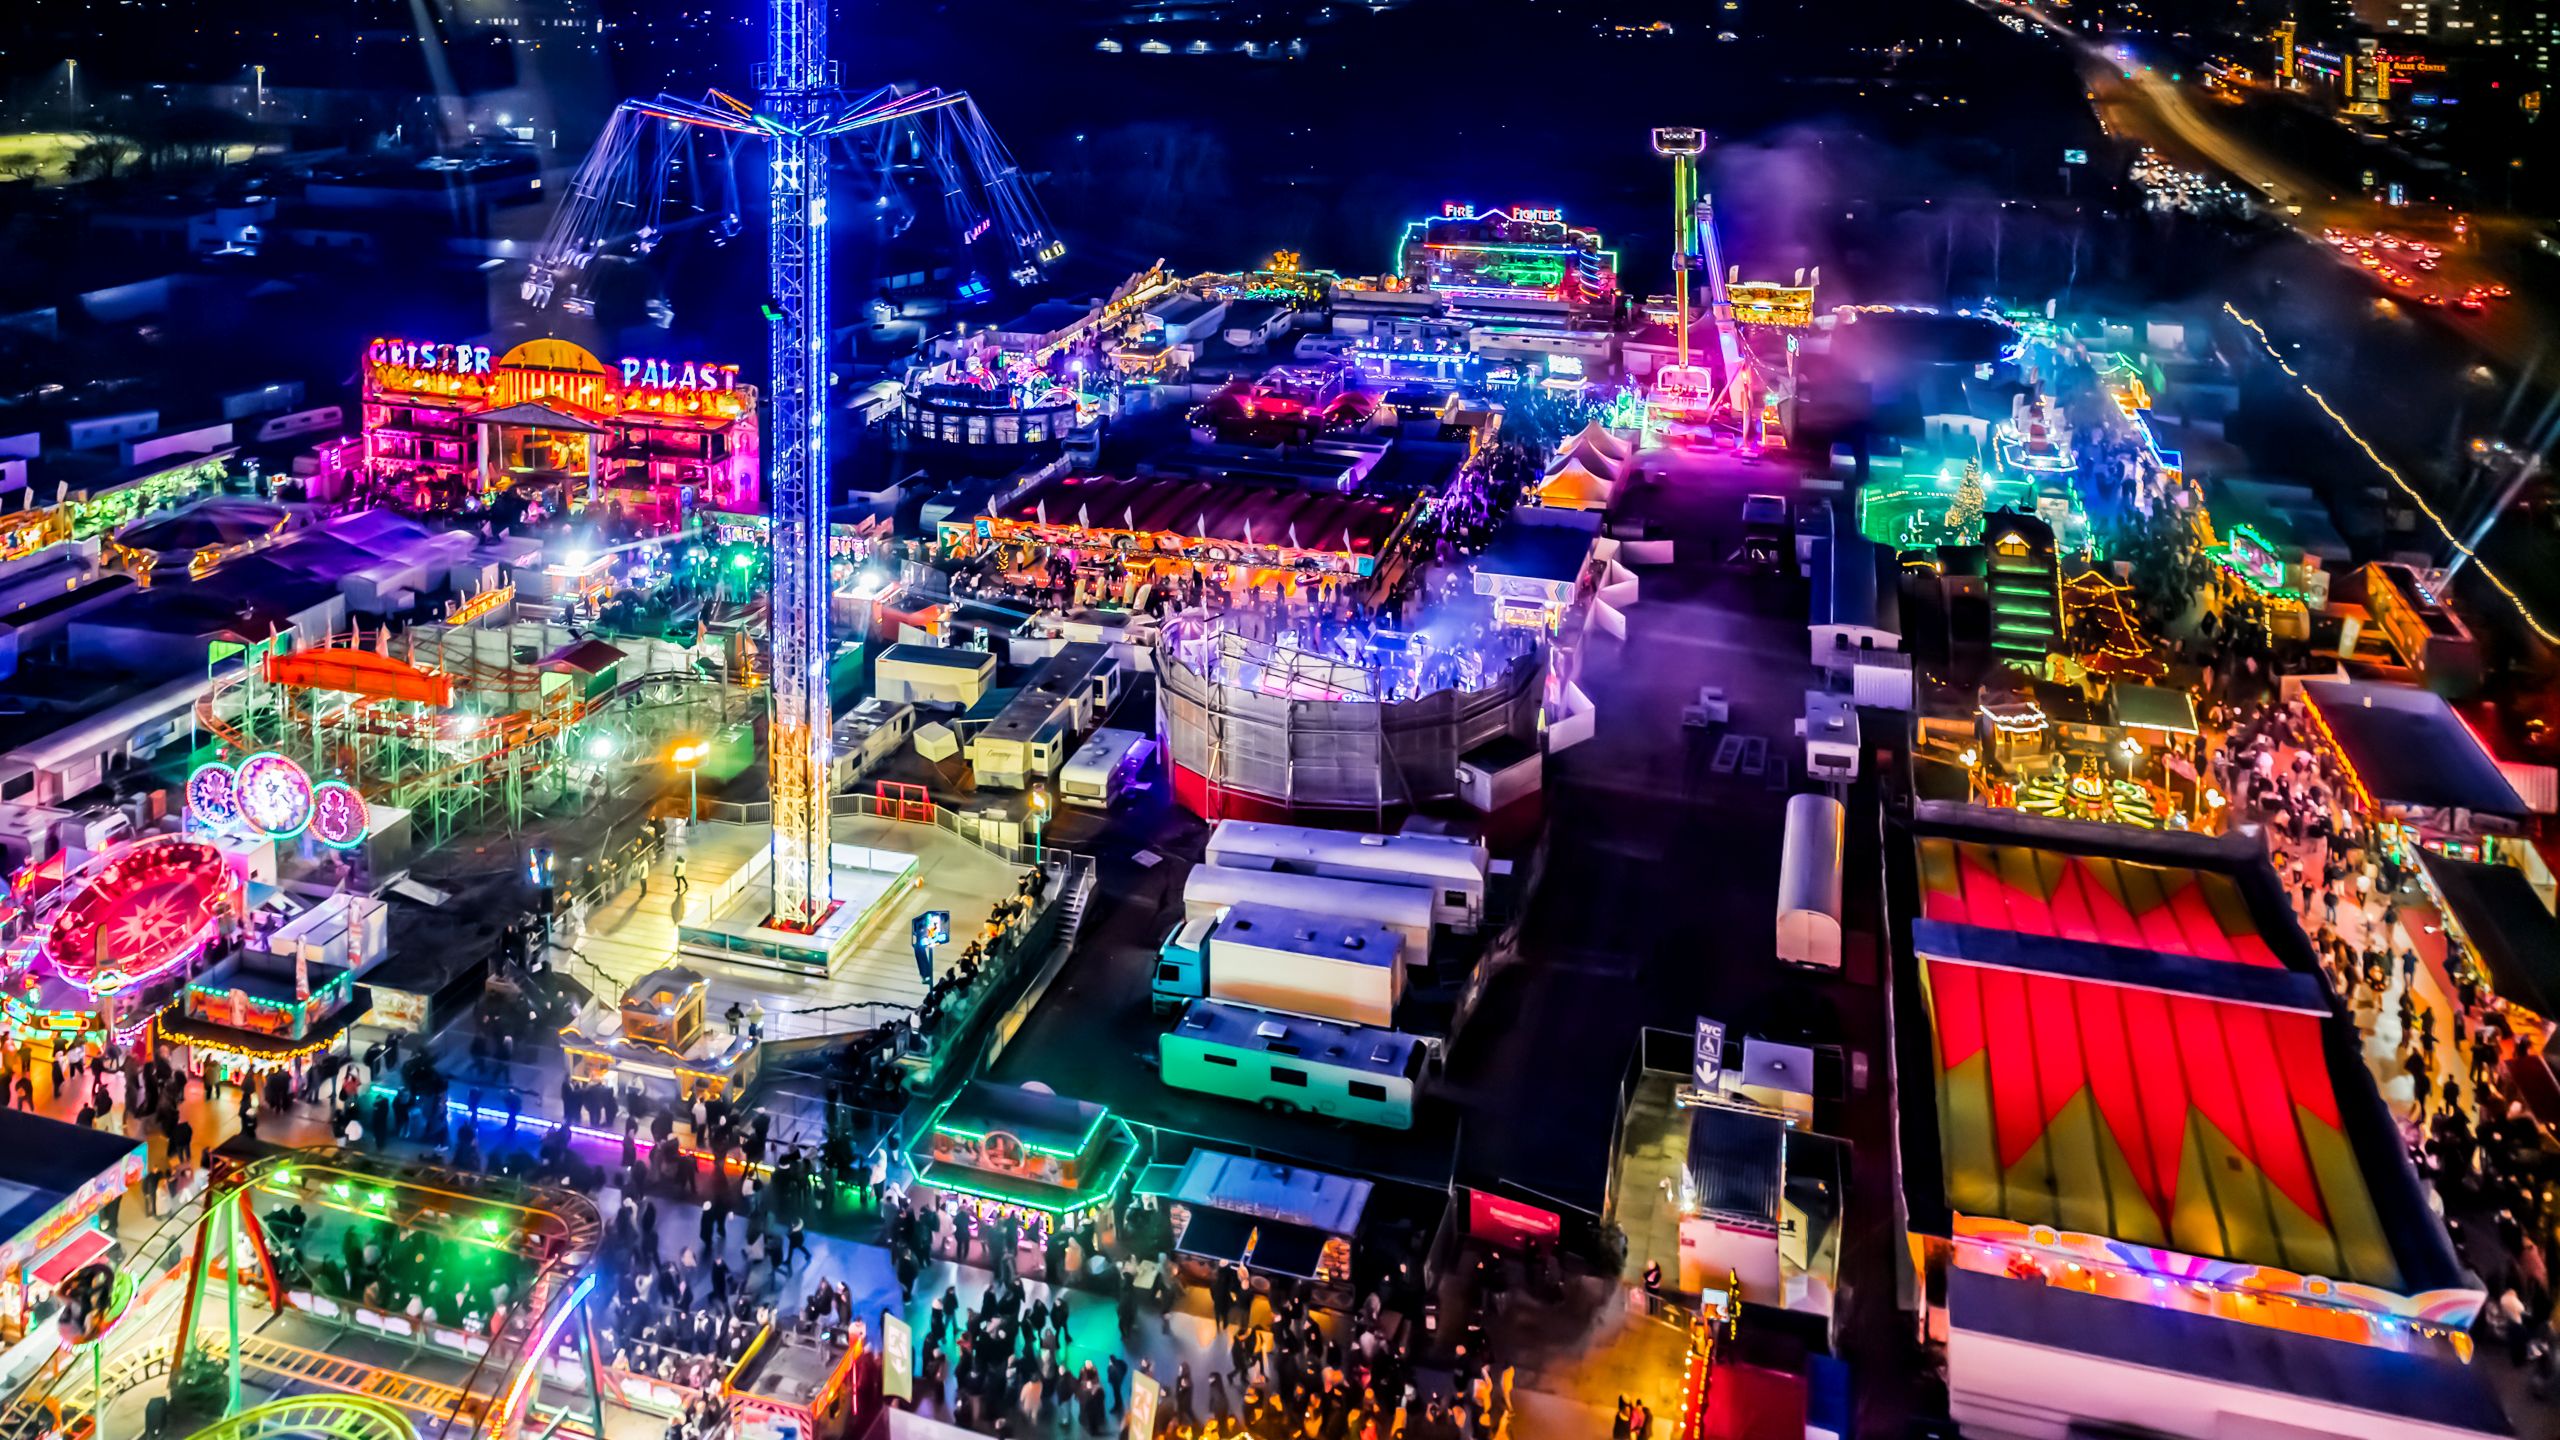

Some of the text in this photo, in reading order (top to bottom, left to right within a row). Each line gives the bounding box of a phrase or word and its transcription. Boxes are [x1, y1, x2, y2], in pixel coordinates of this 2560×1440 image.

[1445, 204, 1562, 221] FIRE FIGHTERS
[369, 337, 740, 395] GEISTER PALAST
[1699, 1022, 1721, 1037] WC
